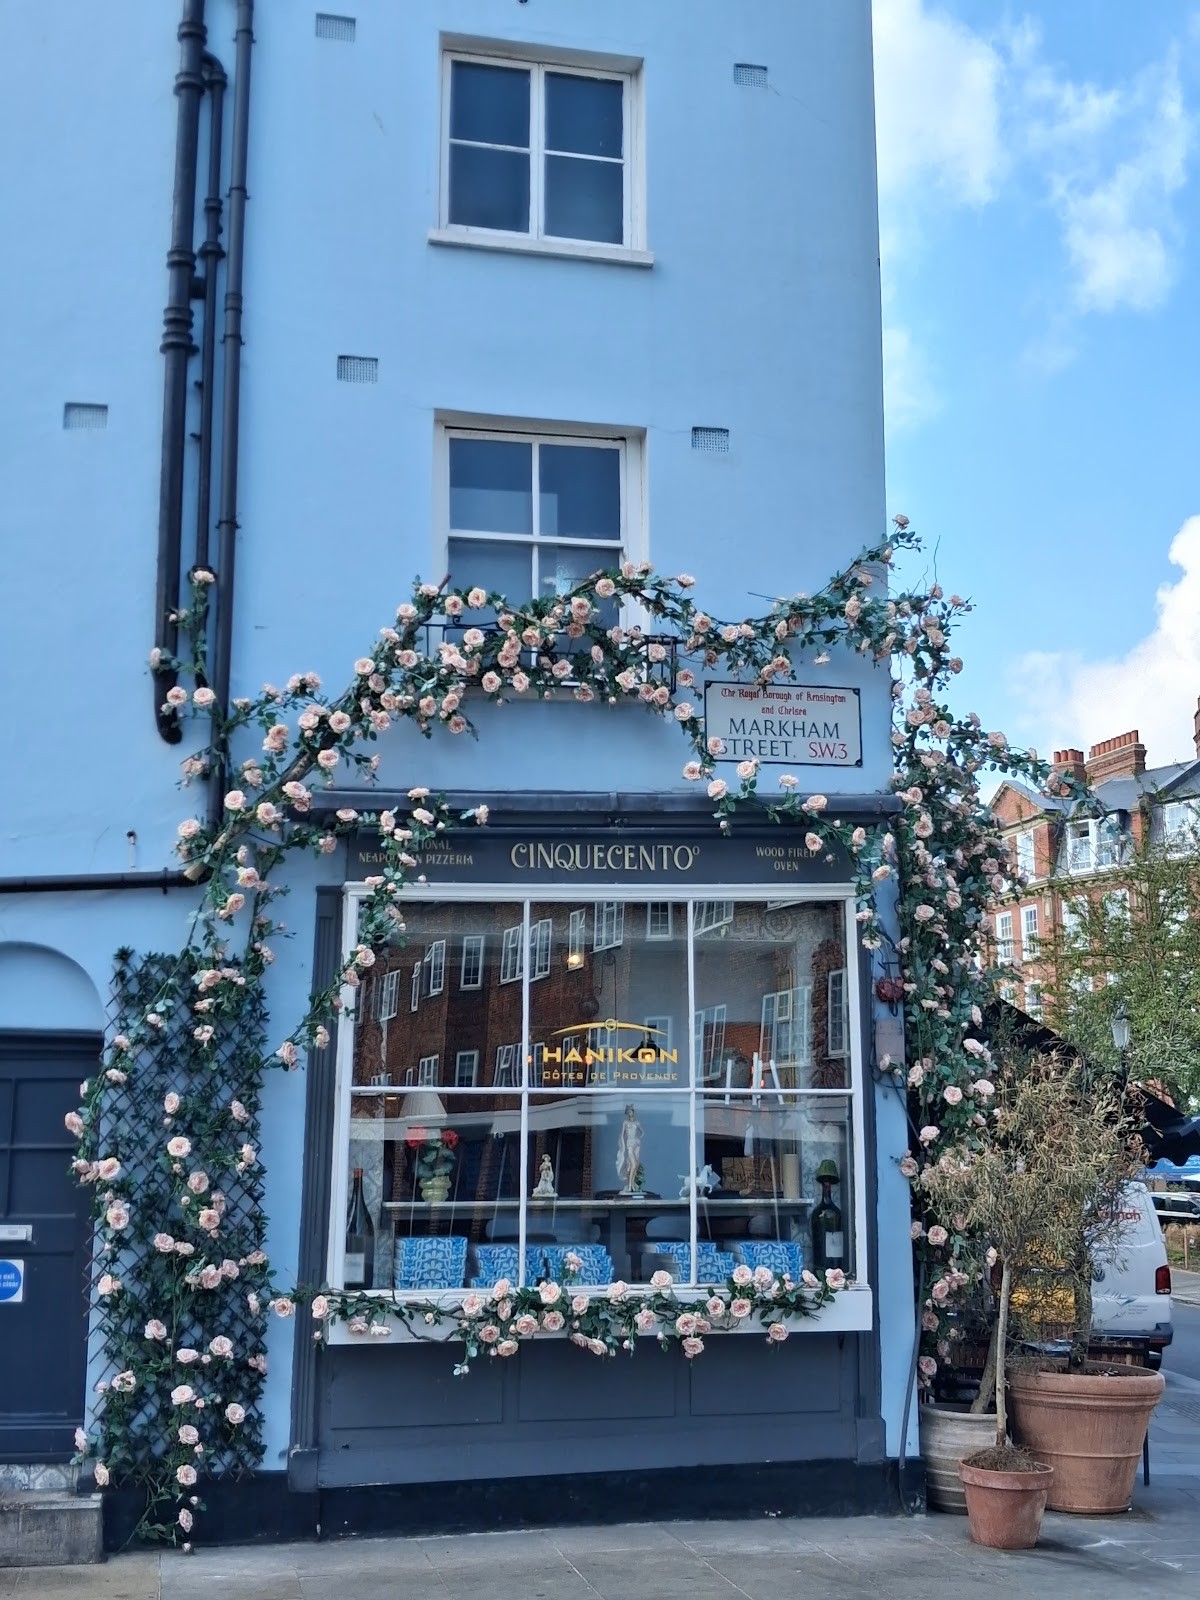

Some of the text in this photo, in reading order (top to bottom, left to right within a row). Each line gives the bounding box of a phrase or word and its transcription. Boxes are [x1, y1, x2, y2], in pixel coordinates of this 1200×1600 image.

[721, 688, 846, 704] The Royal Borough of Kensington
[761, 705, 807, 716] and Chelsea
[728, 718, 840, 739] MARKHAM
[755, 846, 817, 858] WOOD FIRED
[426, 853, 474, 865] PIZZERIA
[773, 861, 799, 871] OVEN
[543, 1047, 678, 1064] HANIKON
